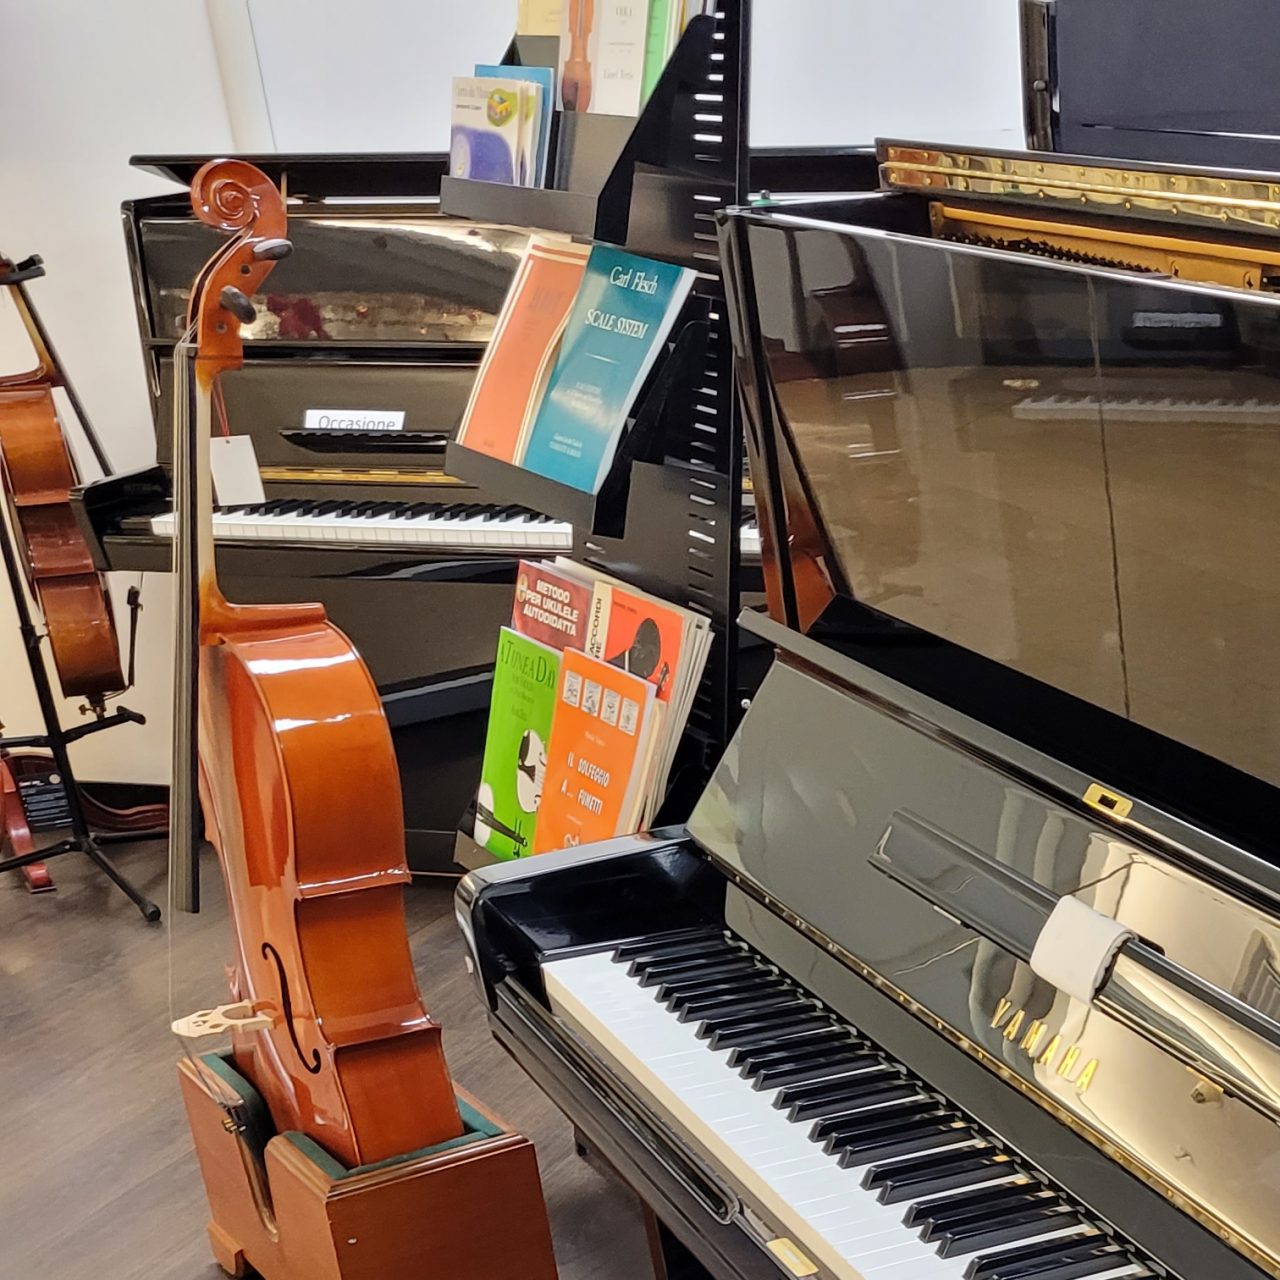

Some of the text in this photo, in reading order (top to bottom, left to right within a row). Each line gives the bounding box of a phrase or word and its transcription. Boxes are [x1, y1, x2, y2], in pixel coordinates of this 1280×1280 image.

[610, 266, 659, 294] Carl Flesch
[585, 309, 649, 339] SCALE SYSTEM
[318, 415, 396, 430] Occasione
[525, 589, 579, 622] PER UKULELE
[536, 579, 571, 604] METODO
[523, 603, 577, 637] AUTODIDATTA
[589, 597, 603, 655] ACCORDI
[567, 751, 611, 788] IL SOLFEGGIO
[577, 788, 604, 816] FUMETTI
[989, 998, 1098, 1092] YAMAHA
